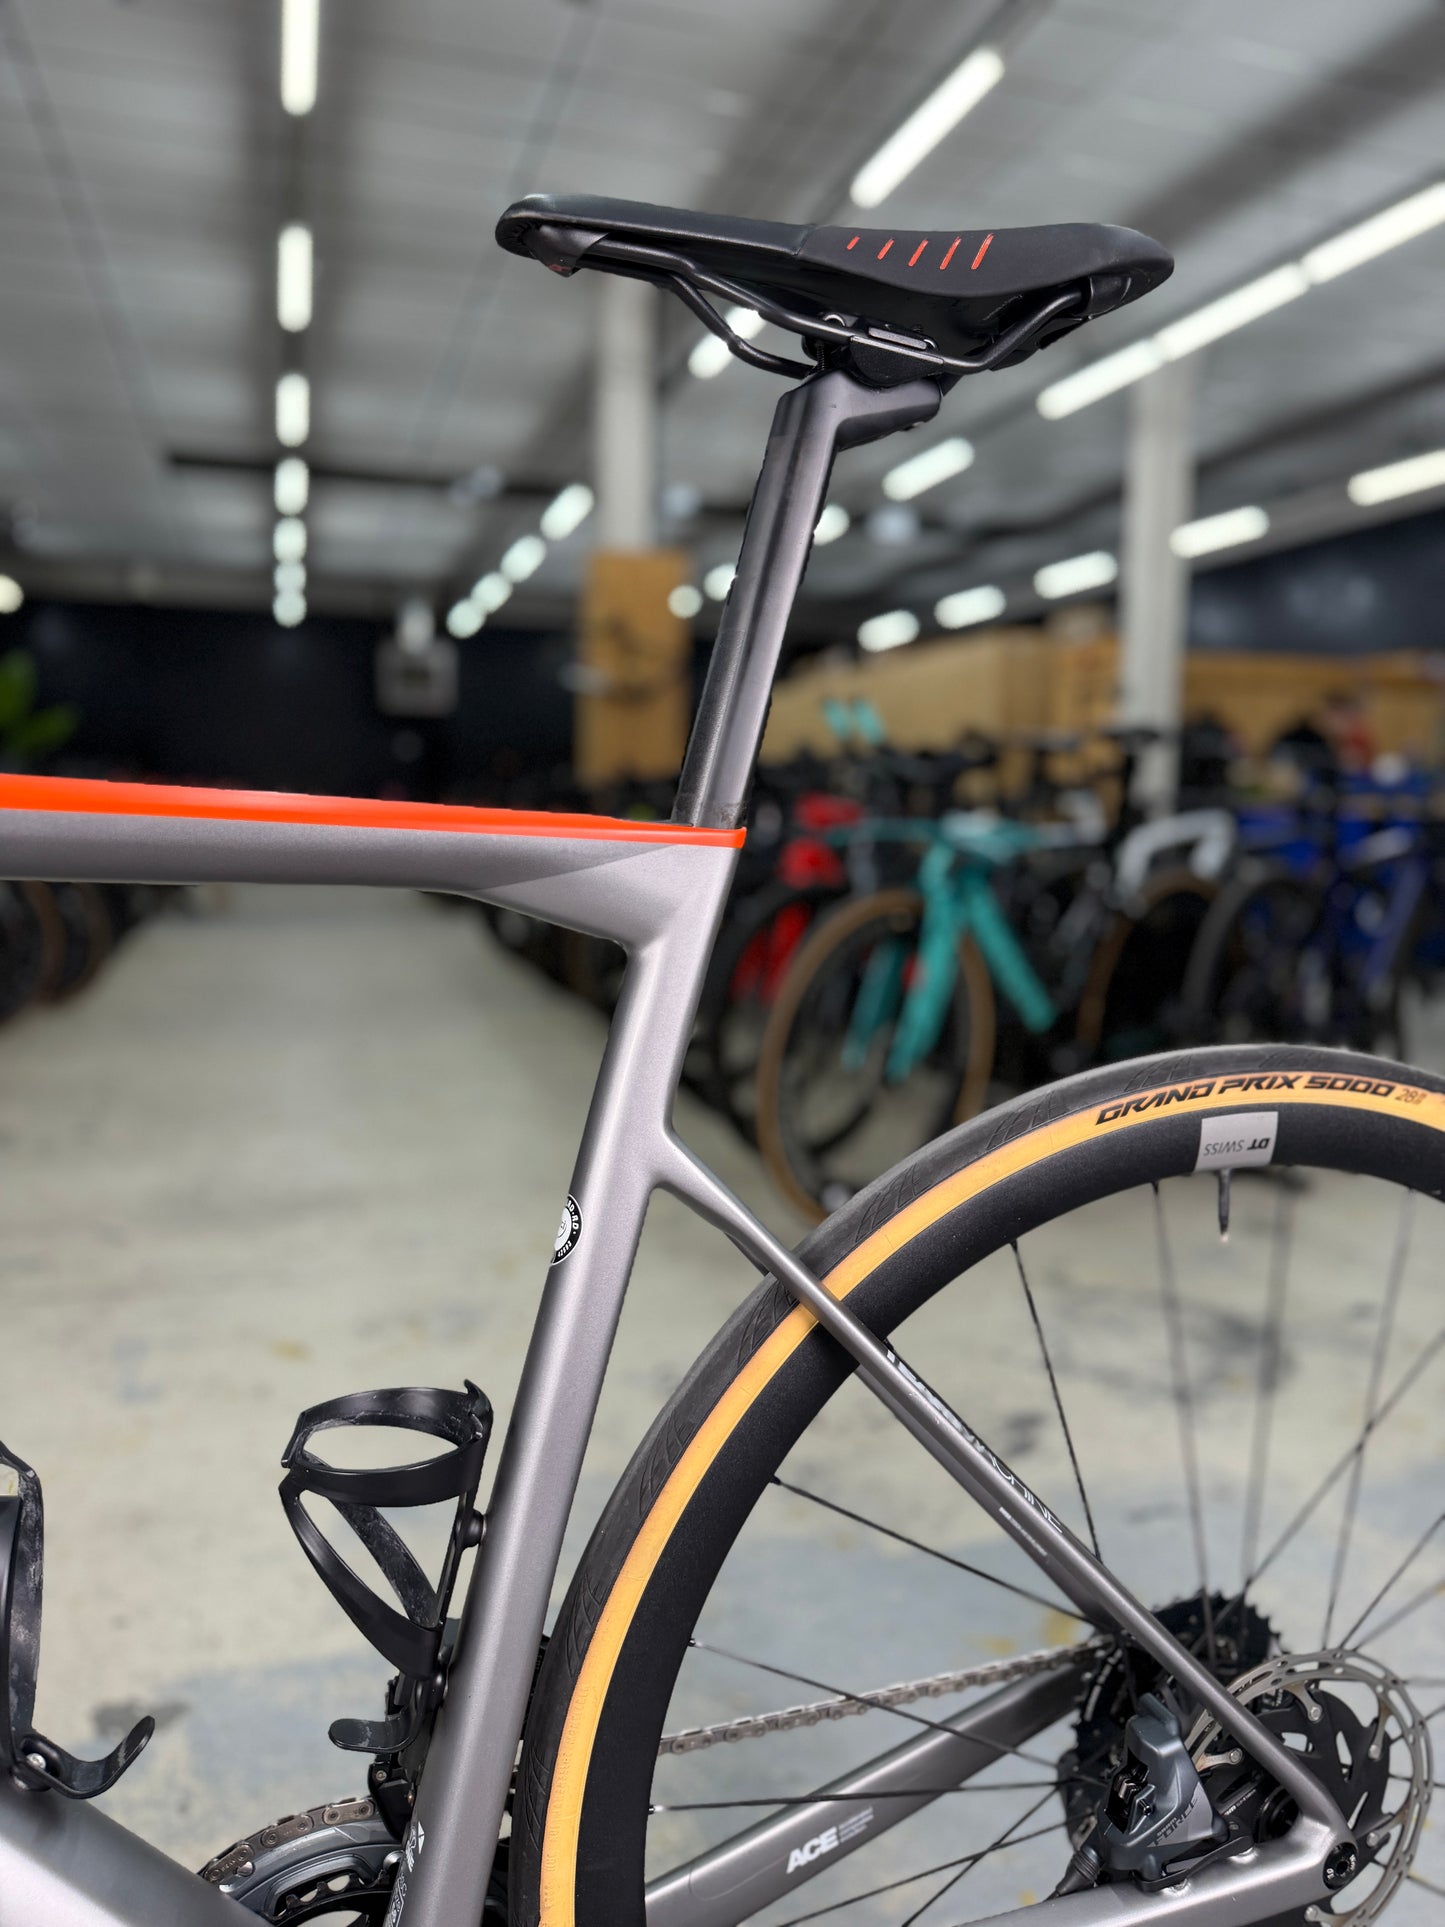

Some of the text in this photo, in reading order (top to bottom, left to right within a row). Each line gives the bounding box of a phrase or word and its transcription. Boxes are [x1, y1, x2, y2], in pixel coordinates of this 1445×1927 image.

[1096, 1075, 1396, 1125] GRAND PRIX 5000
[1203, 1137, 1272, 1157] DT SWISS
[786, 1826, 839, 1874] ACE
